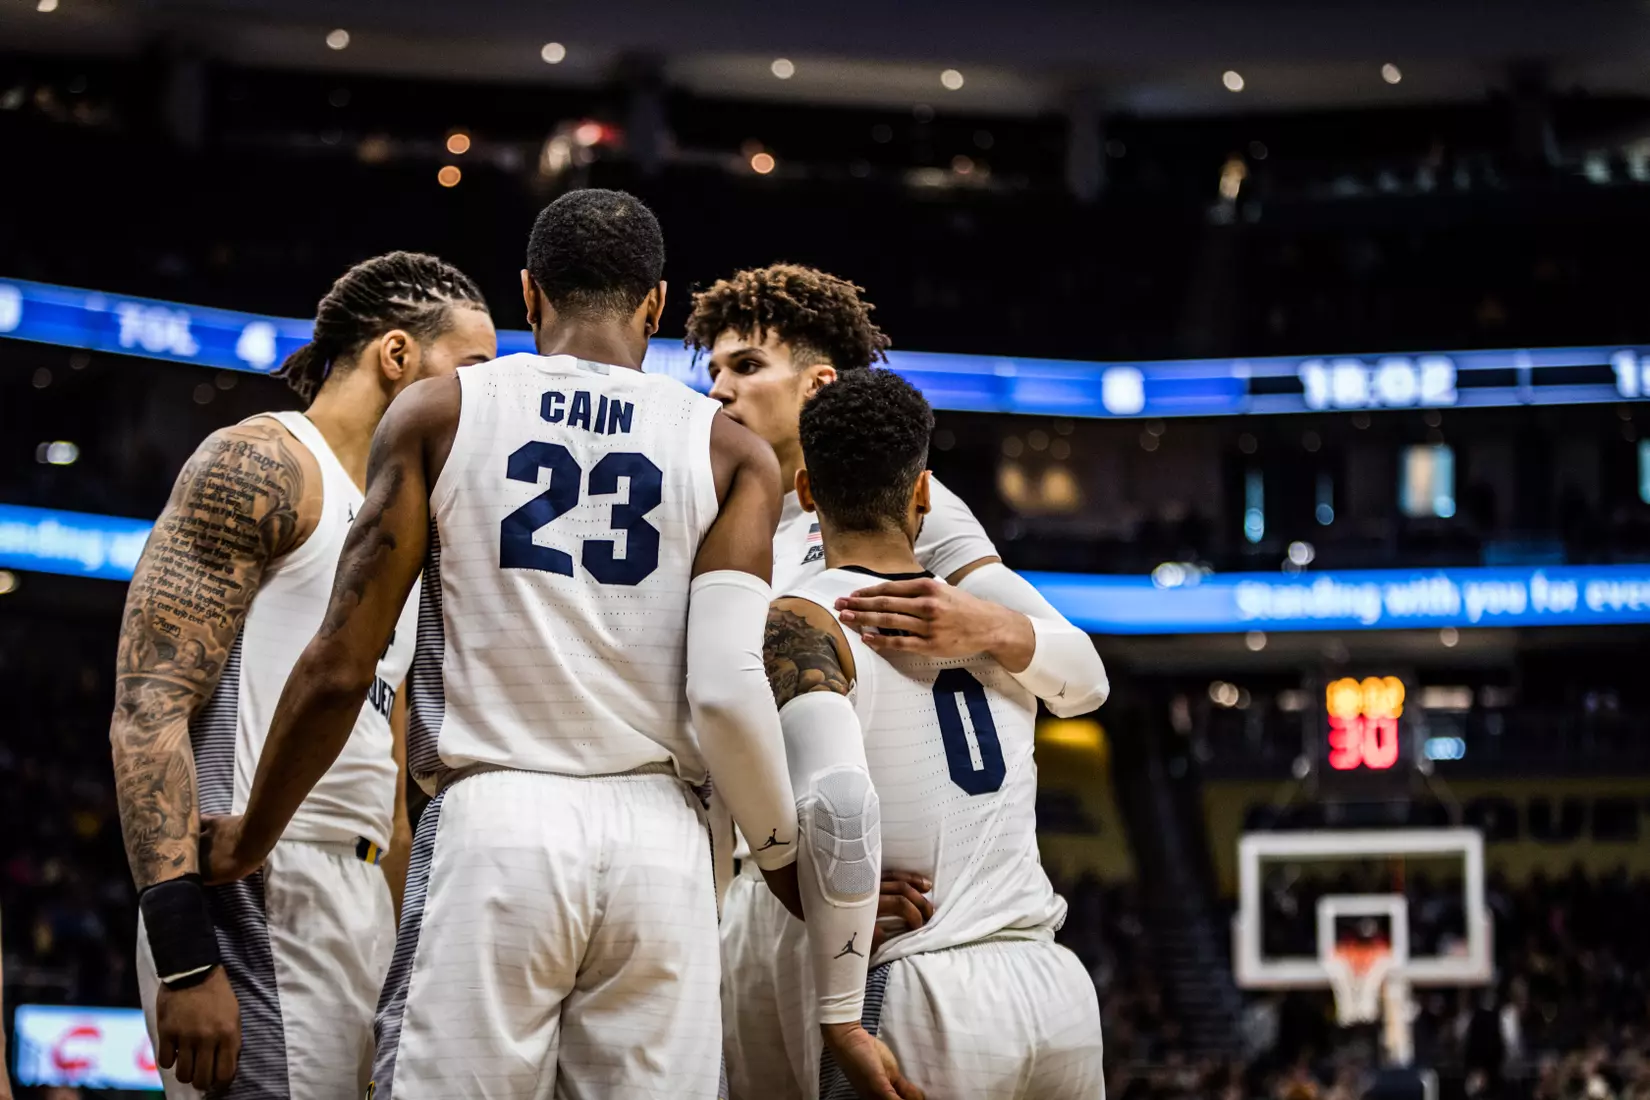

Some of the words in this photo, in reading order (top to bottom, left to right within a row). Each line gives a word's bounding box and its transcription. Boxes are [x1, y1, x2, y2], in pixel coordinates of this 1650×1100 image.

[540, 390, 634, 434] CAIN
[500, 440, 663, 586] 23
[1235, 575, 1382, 625] Standing
[1383, 570, 1461, 618] with
[1462, 580, 1527, 624] you
[1529, 569, 1578, 614] for
[1583, 577, 1650, 613] eve
[932, 668, 1007, 796] 0
[1327, 715, 1399, 770] 30
